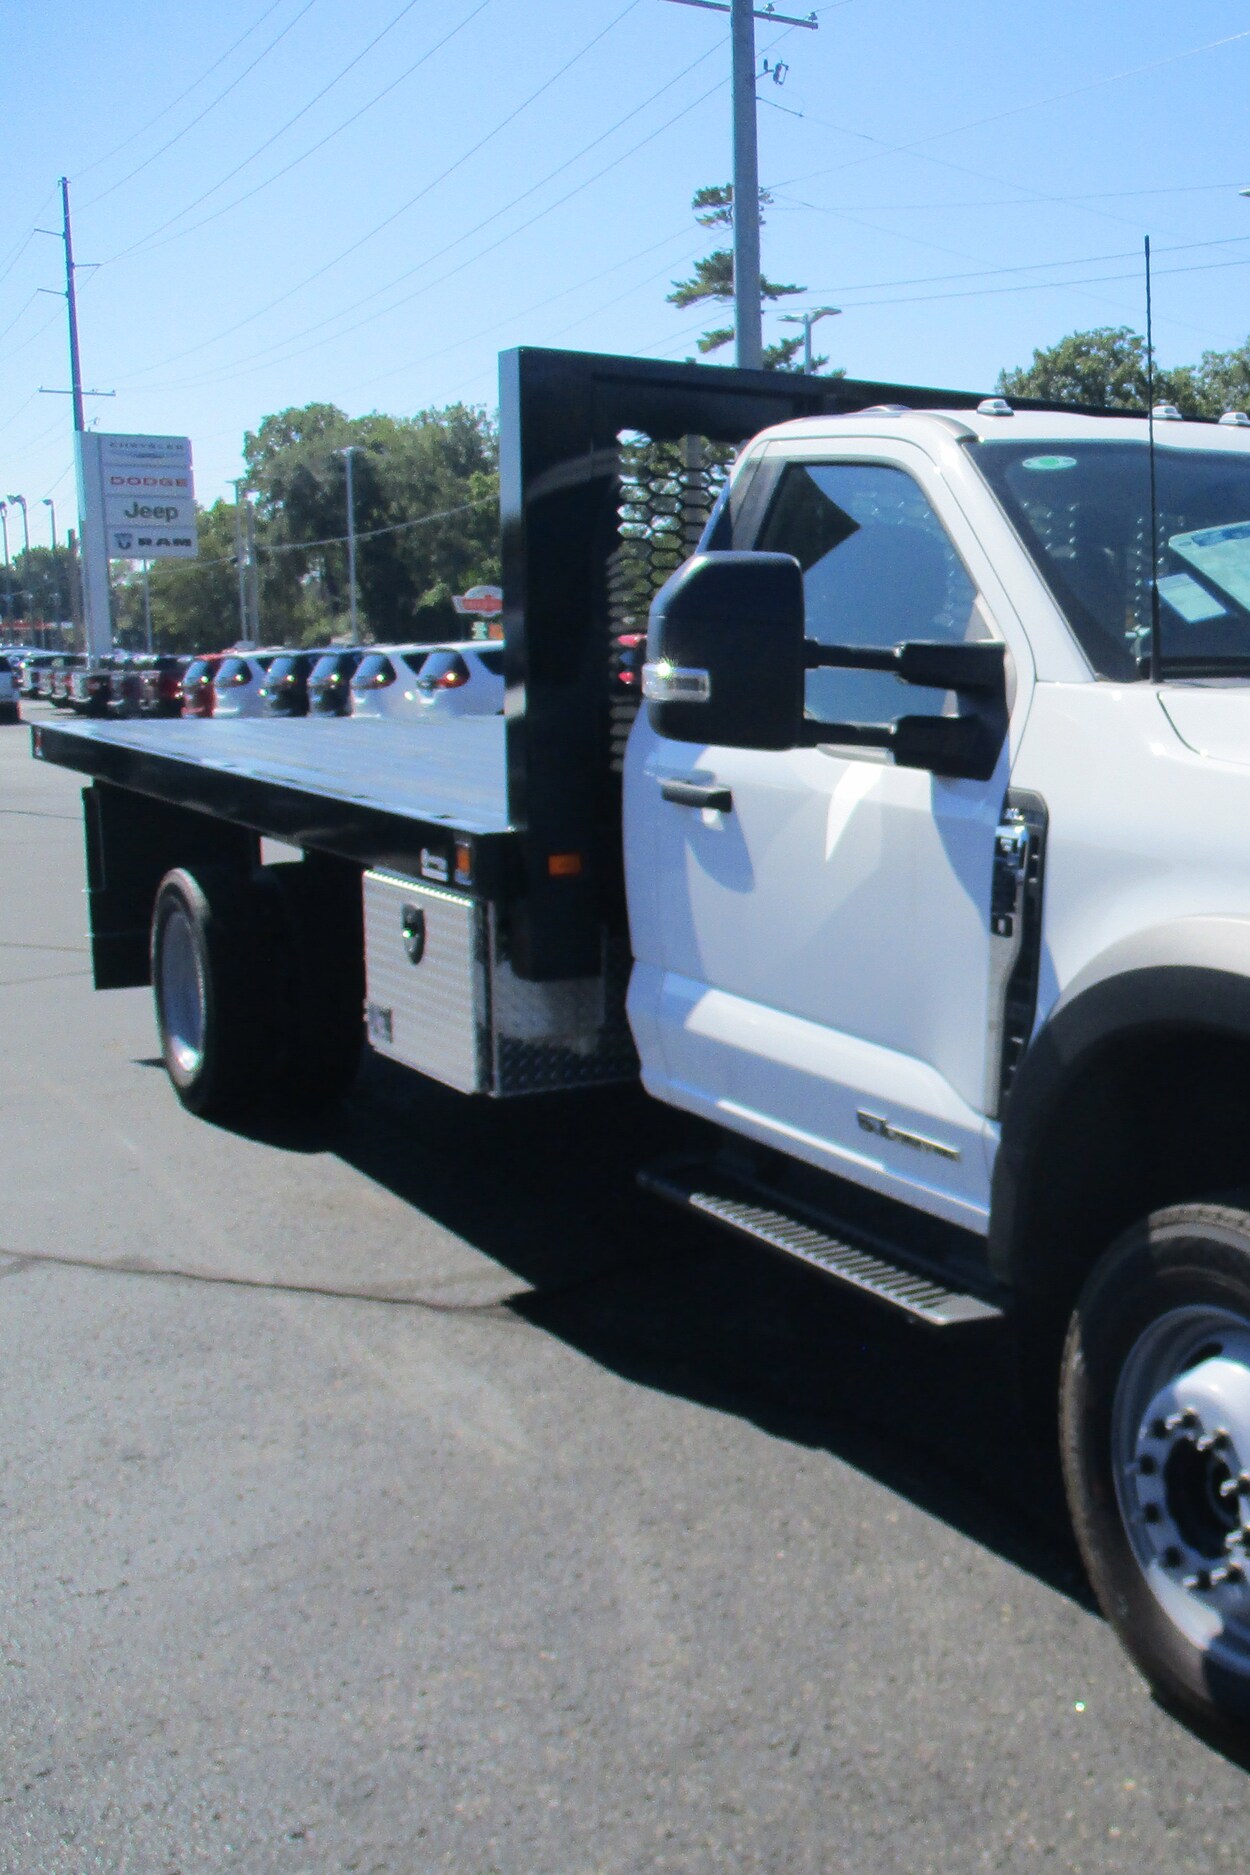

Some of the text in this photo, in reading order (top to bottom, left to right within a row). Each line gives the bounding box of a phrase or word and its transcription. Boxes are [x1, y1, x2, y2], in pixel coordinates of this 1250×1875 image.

[110, 476, 188, 487] DODGE
[124, 501, 179, 522] Jeep
[138, 537, 193, 547] RAM
